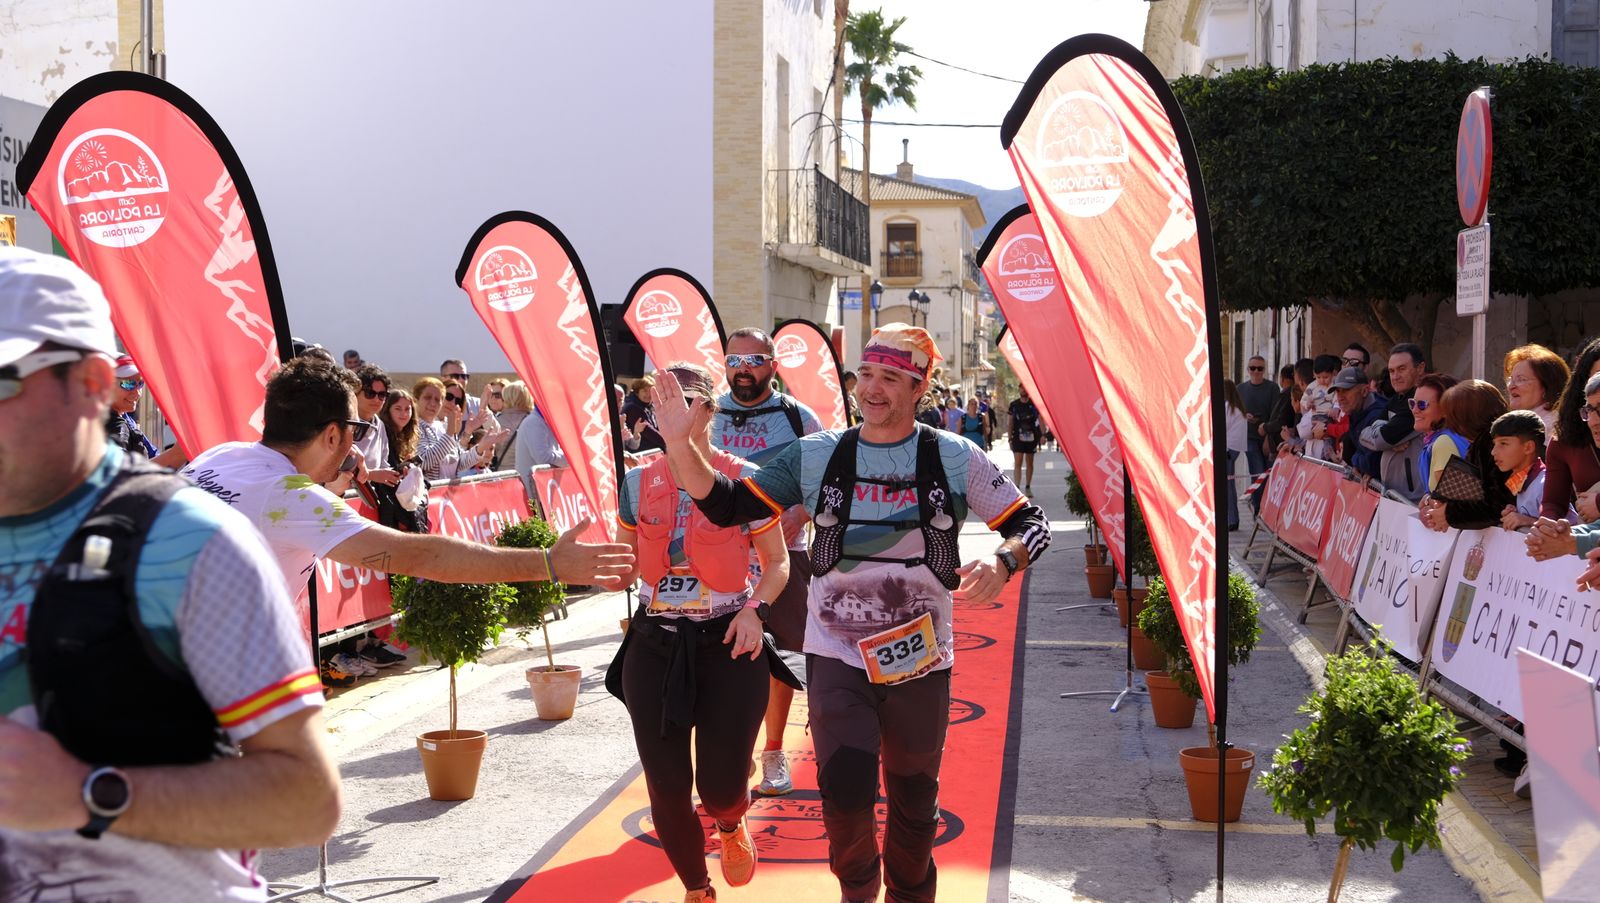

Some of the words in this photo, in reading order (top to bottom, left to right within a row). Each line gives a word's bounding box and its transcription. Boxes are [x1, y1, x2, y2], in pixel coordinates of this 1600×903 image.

[722, 420, 769, 434] PURA
[721, 433, 768, 452] VIDA
[854, 484, 919, 510] VIDA
[658, 576, 699, 593] 297
[876, 633, 925, 666] 332
